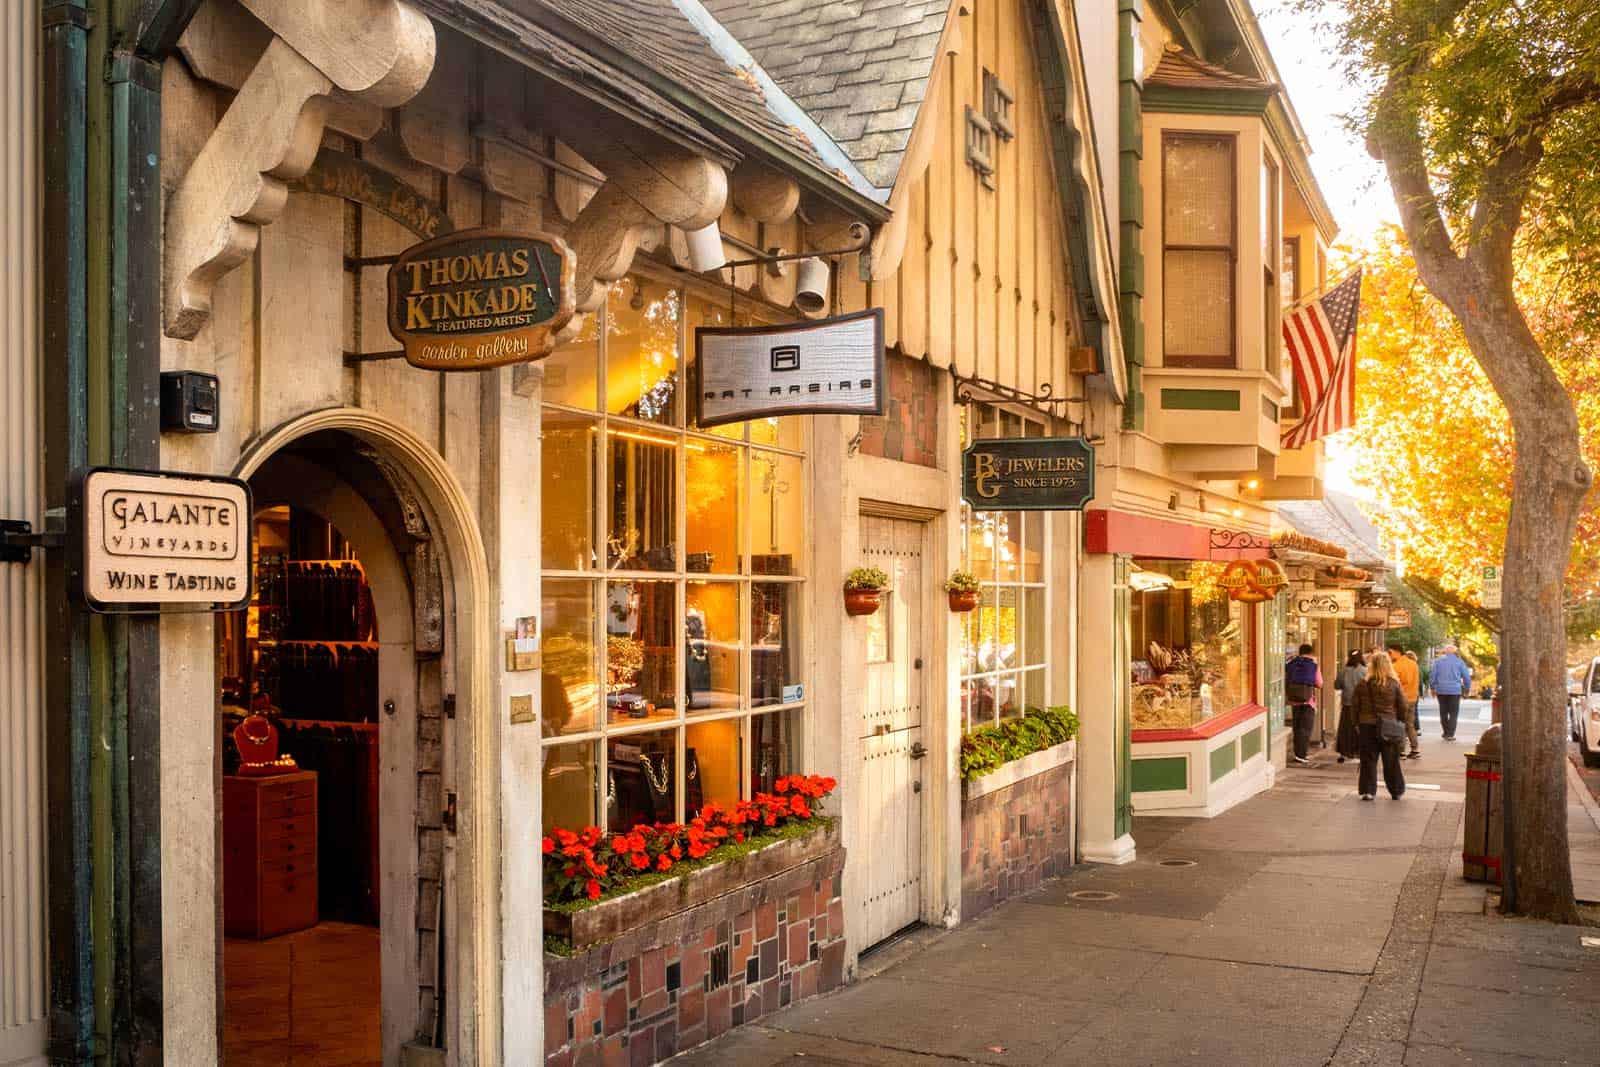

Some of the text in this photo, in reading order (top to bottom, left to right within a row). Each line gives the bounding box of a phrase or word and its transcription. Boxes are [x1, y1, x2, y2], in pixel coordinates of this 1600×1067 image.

[406, 249, 529, 294] THOMAS
[405, 284, 537, 330] KINKADE
[436, 314, 533, 332] FEATURED ARTIST
[418, 335, 529, 361] garden gallery
[1005, 456, 1086, 475] JEWELERS
[1013, 477, 1077, 488] SINCE 1973
[112, 497, 231, 530] GALANTE
[112, 535, 229, 552] VINEYARDS
